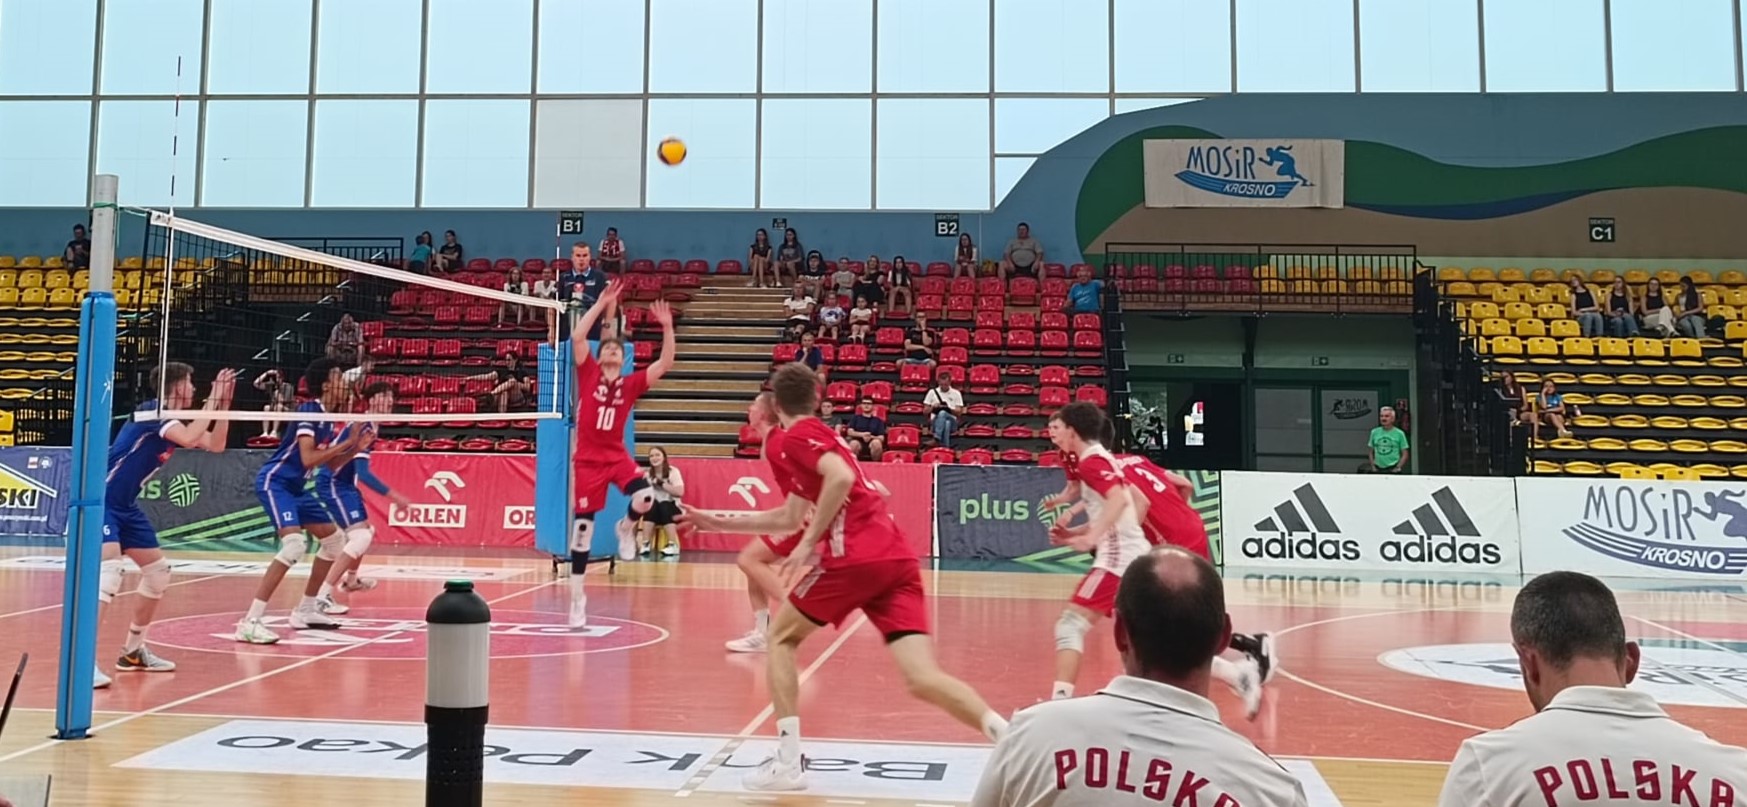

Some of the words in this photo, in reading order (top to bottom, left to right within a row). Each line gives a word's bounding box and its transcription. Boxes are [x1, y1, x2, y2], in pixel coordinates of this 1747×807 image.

[1186, 146, 1256, 180] MOSiR
[1223, 184, 1276, 196] KROSNO
[563, 219, 581, 232] B1
[938, 222, 957, 234] B2
[1592, 227, 1612, 240] C1
[596, 406, 616, 431] 10
[1134, 467, 1166, 493] 3
[393, 506, 461, 524] ORLEN
[959, 493, 1030, 525] plus
[1583, 485, 1696, 541] MOSiR
[1241, 532, 1361, 560] adidas
[1379, 534, 1502, 564] adidas
[1641, 545, 1726, 570] KROSNO
